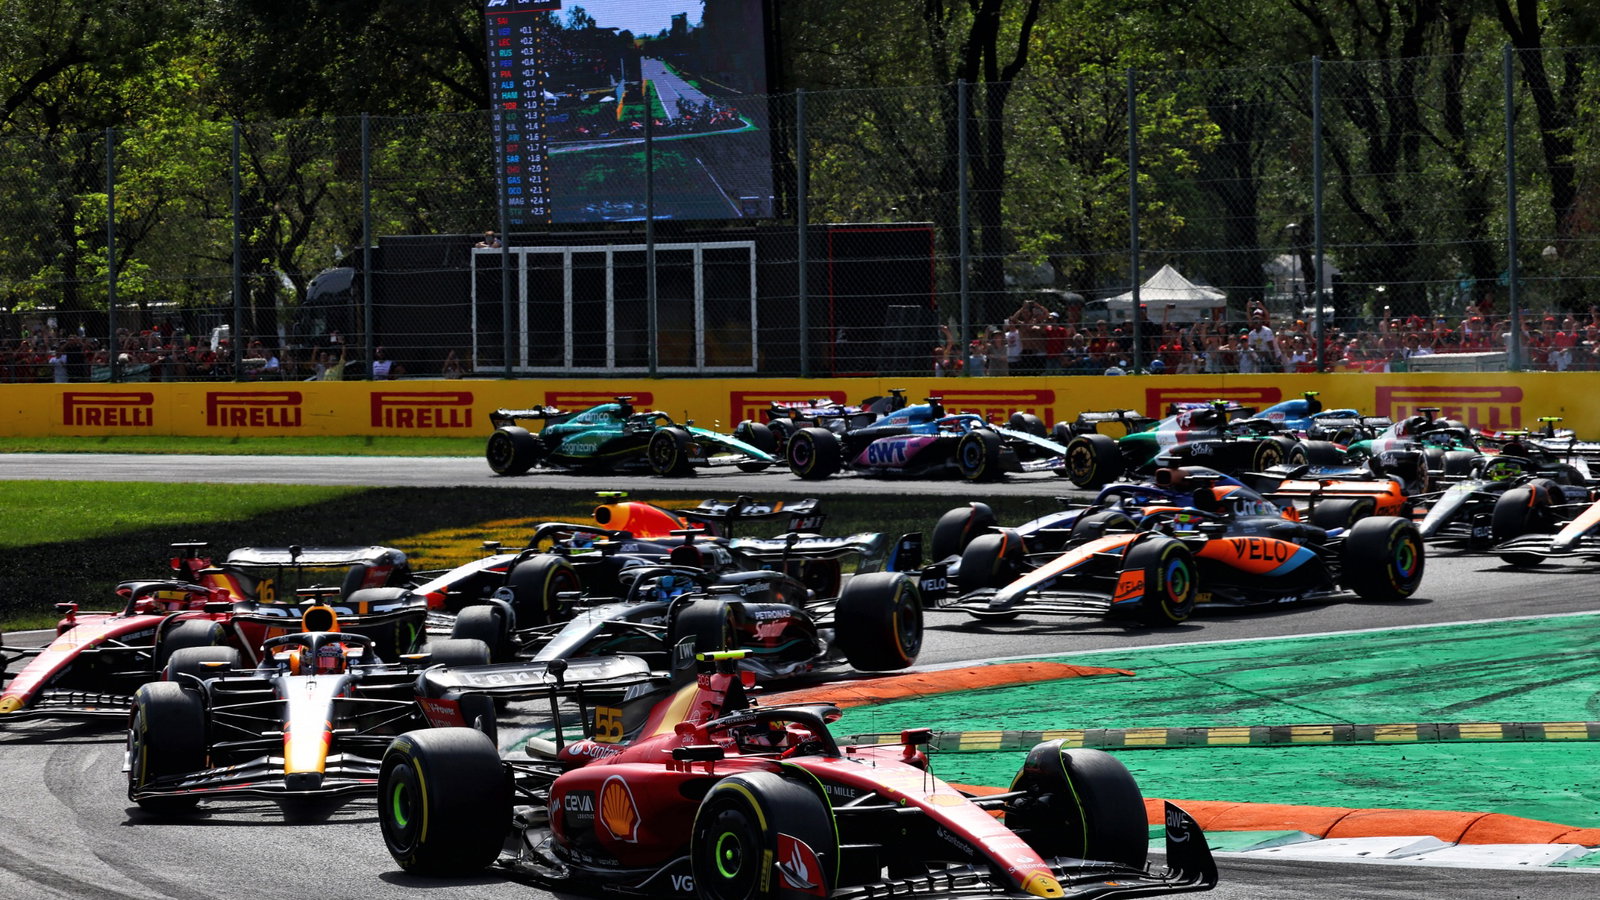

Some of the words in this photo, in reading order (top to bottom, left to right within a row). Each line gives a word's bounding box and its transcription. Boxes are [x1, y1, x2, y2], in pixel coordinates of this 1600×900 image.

[520, 26, 532, 34] +0.1
[499, 38, 511, 46] LEC
[520, 37, 533, 45] +0.2
[499, 49, 513, 57] RUS
[521, 48, 534, 56] +0.3
[521, 58, 535, 66] +0.4
[500, 70, 512, 78] PIA
[522, 69, 535, 77] +0.7
[501, 81, 515, 89] ALB
[523, 80, 536, 88] +0.7
[501, 91, 518, 99] HAM
[524, 90, 537, 99] +1.0
[524, 101, 537, 109] +1.0
[525, 111, 538, 119] +1.3
[525, 122, 539, 130] +1.4
[526, 133, 539, 141] +1.6
[526, 143, 539, 151] +1.7
[506, 154, 520, 163] SAR
[527, 154, 541, 162] +1.8
[507, 176, 521, 184] GAS
[529, 175, 542, 183] +2.1
[508, 187, 522, 195] OCO
[530, 186, 543, 194] +2.1
[508, 197, 525, 205] MAG
[530, 196, 544, 204] +2.4
[531, 207, 544, 215] +2.5
[63, 392, 154, 426] PIRELLI
[206, 391, 303, 427] PIRELLI
[370, 392, 474, 428] PIRELLI
[576, 412, 609, 422] aramco
[868, 440, 907, 465] BWT
[1191, 442, 1214, 457] Stake
[790, 516, 813, 529] Mobil
[1231, 538, 1288, 563] VELO
[921, 577, 947, 591] VELO
[256, 579, 274, 603] 16
[754, 609, 791, 620] PETRONAS
[594, 705, 624, 743] 55
[834, 786, 855, 798] MILLE
[1167, 809, 1188, 828] aws
[671, 874, 693, 892] VG
